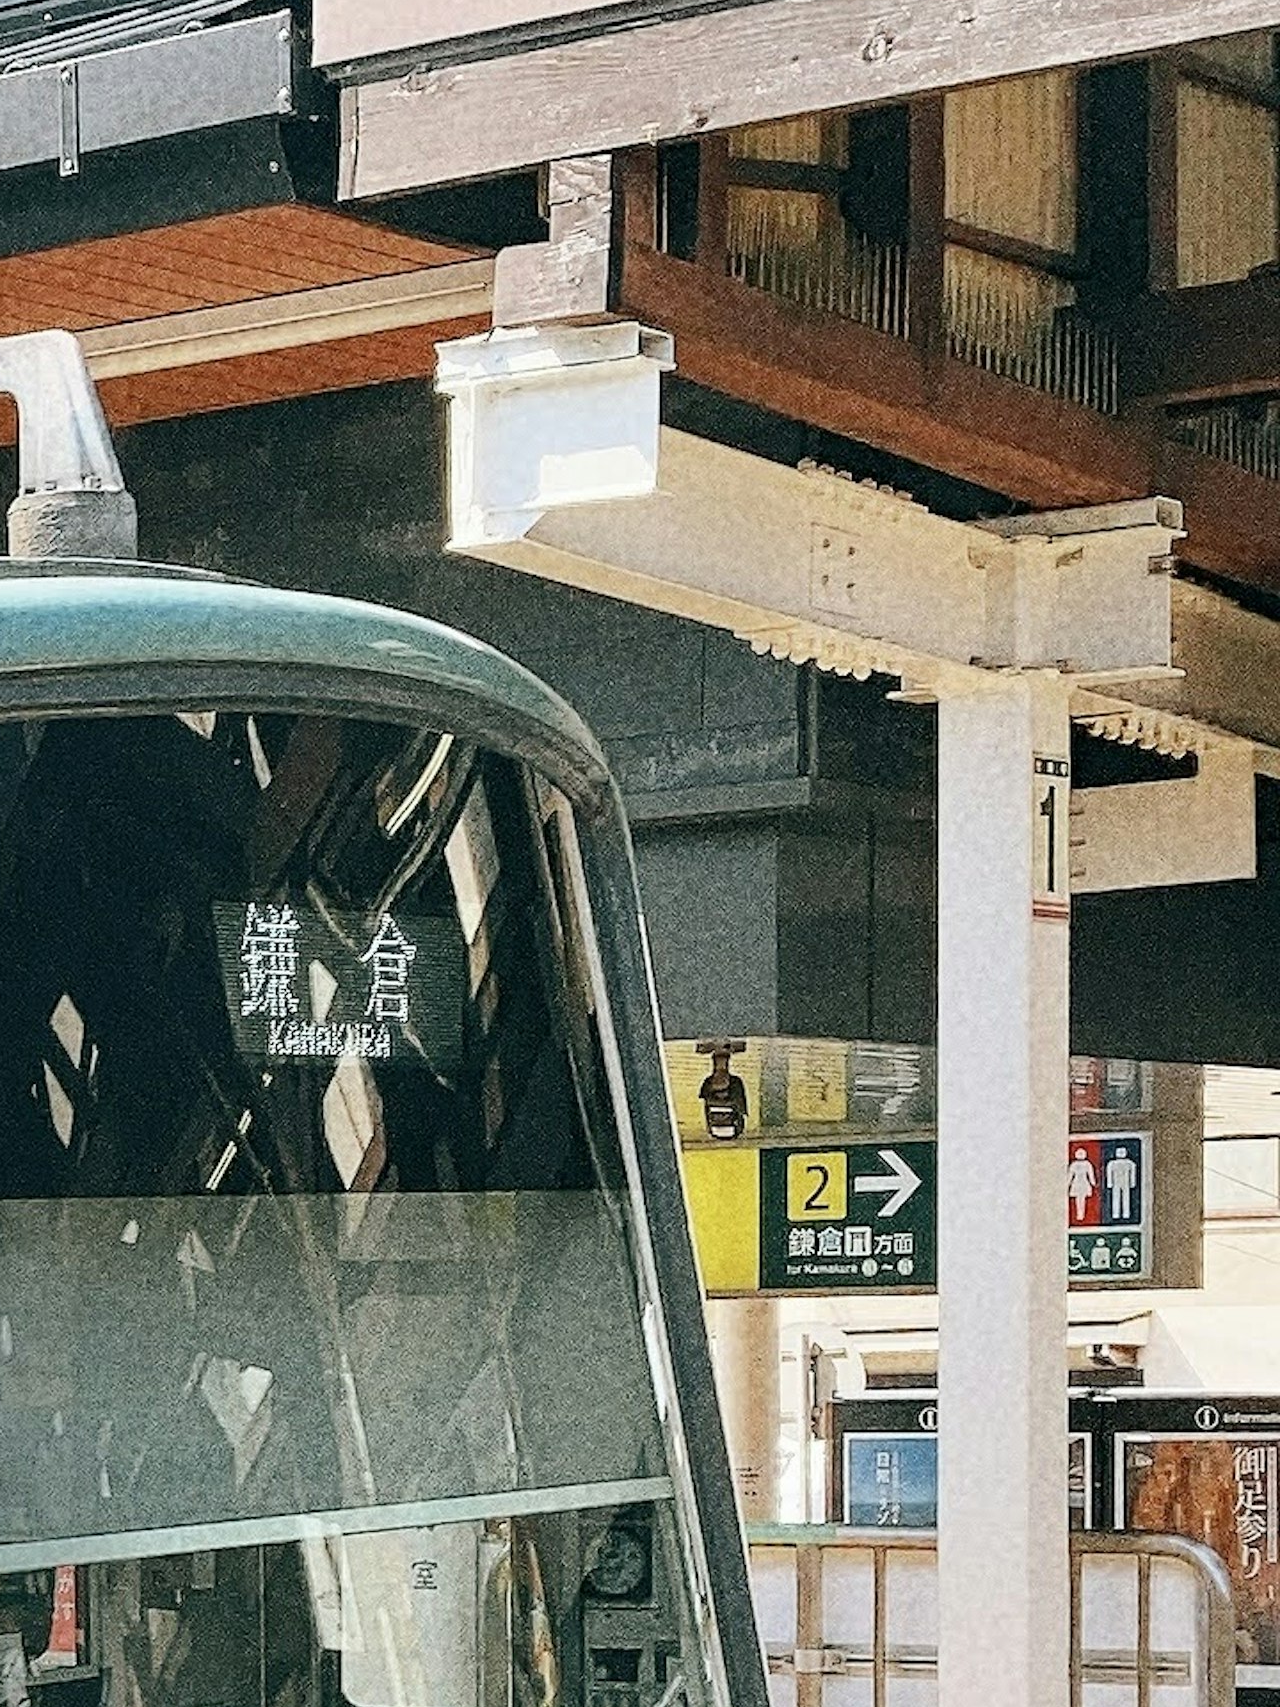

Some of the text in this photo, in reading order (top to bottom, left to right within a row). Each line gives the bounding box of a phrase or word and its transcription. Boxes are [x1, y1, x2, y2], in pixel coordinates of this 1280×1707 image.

[1039, 784, 1056, 893] 1
[239, 901, 418, 1023] 鎌倉
[803, 1165, 830, 1212] 2
[787, 1226, 914, 1257] 鎌倉 方面
[803, 1262, 859, 1275] Kamakura
